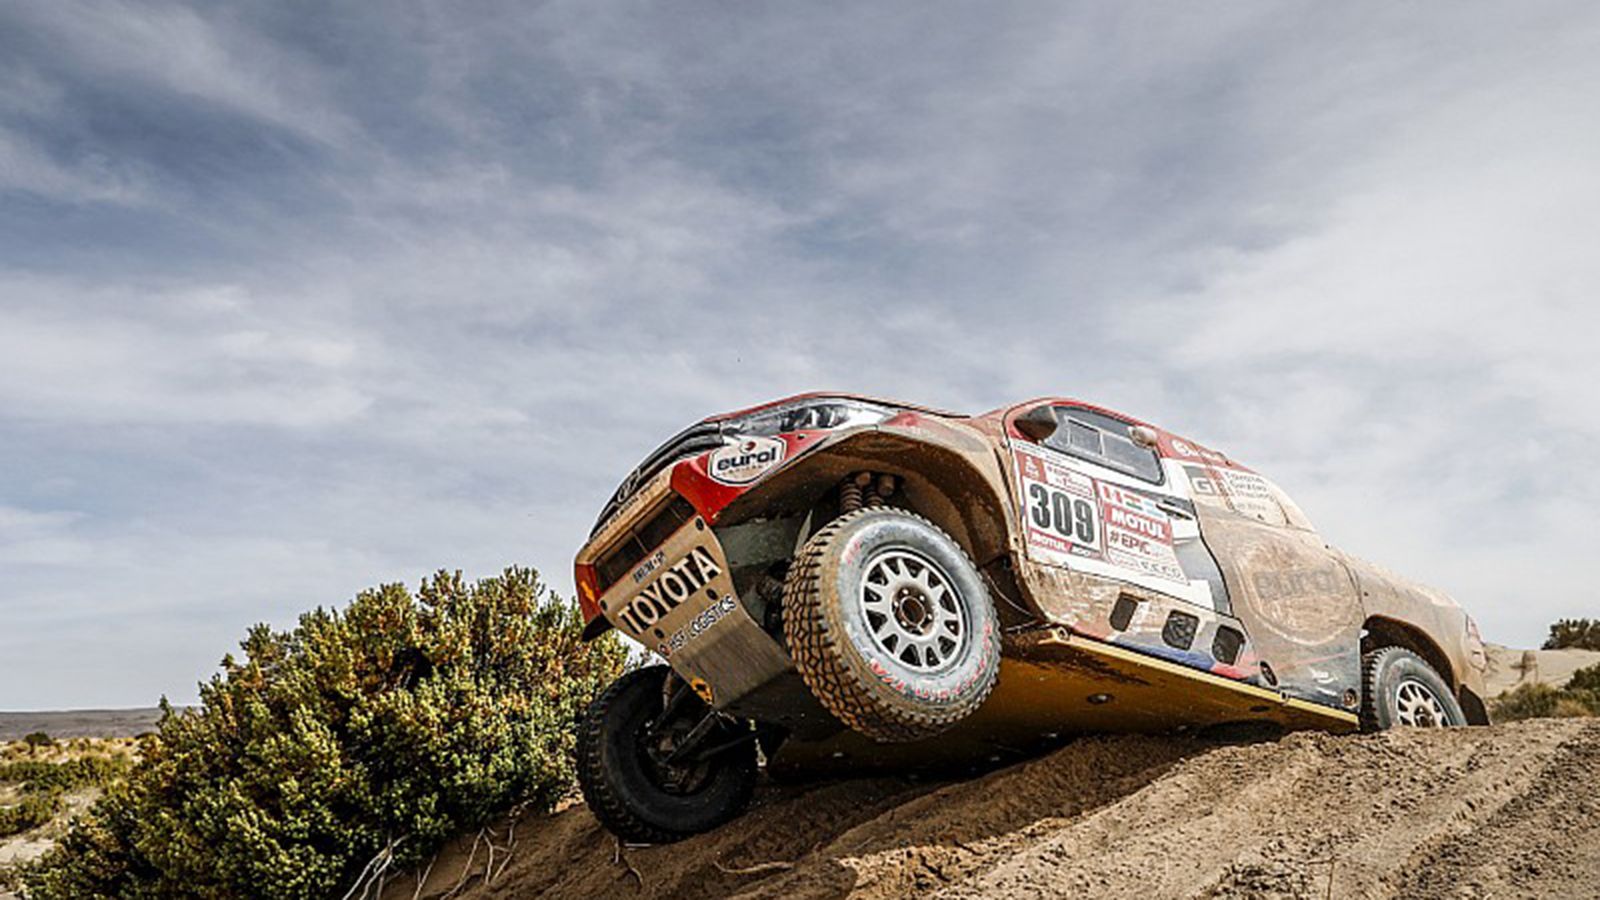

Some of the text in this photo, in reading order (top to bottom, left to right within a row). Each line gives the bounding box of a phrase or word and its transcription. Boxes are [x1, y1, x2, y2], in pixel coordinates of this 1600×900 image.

[717, 447, 776, 471] eurol
[1030, 483, 1095, 544] 309
[1111, 507, 1167, 539] MOTUL
[1030, 531, 1068, 552] MOTUL
[618, 548, 722, 635] TOYOTA
[689, 594, 737, 640] LOGISTICS
